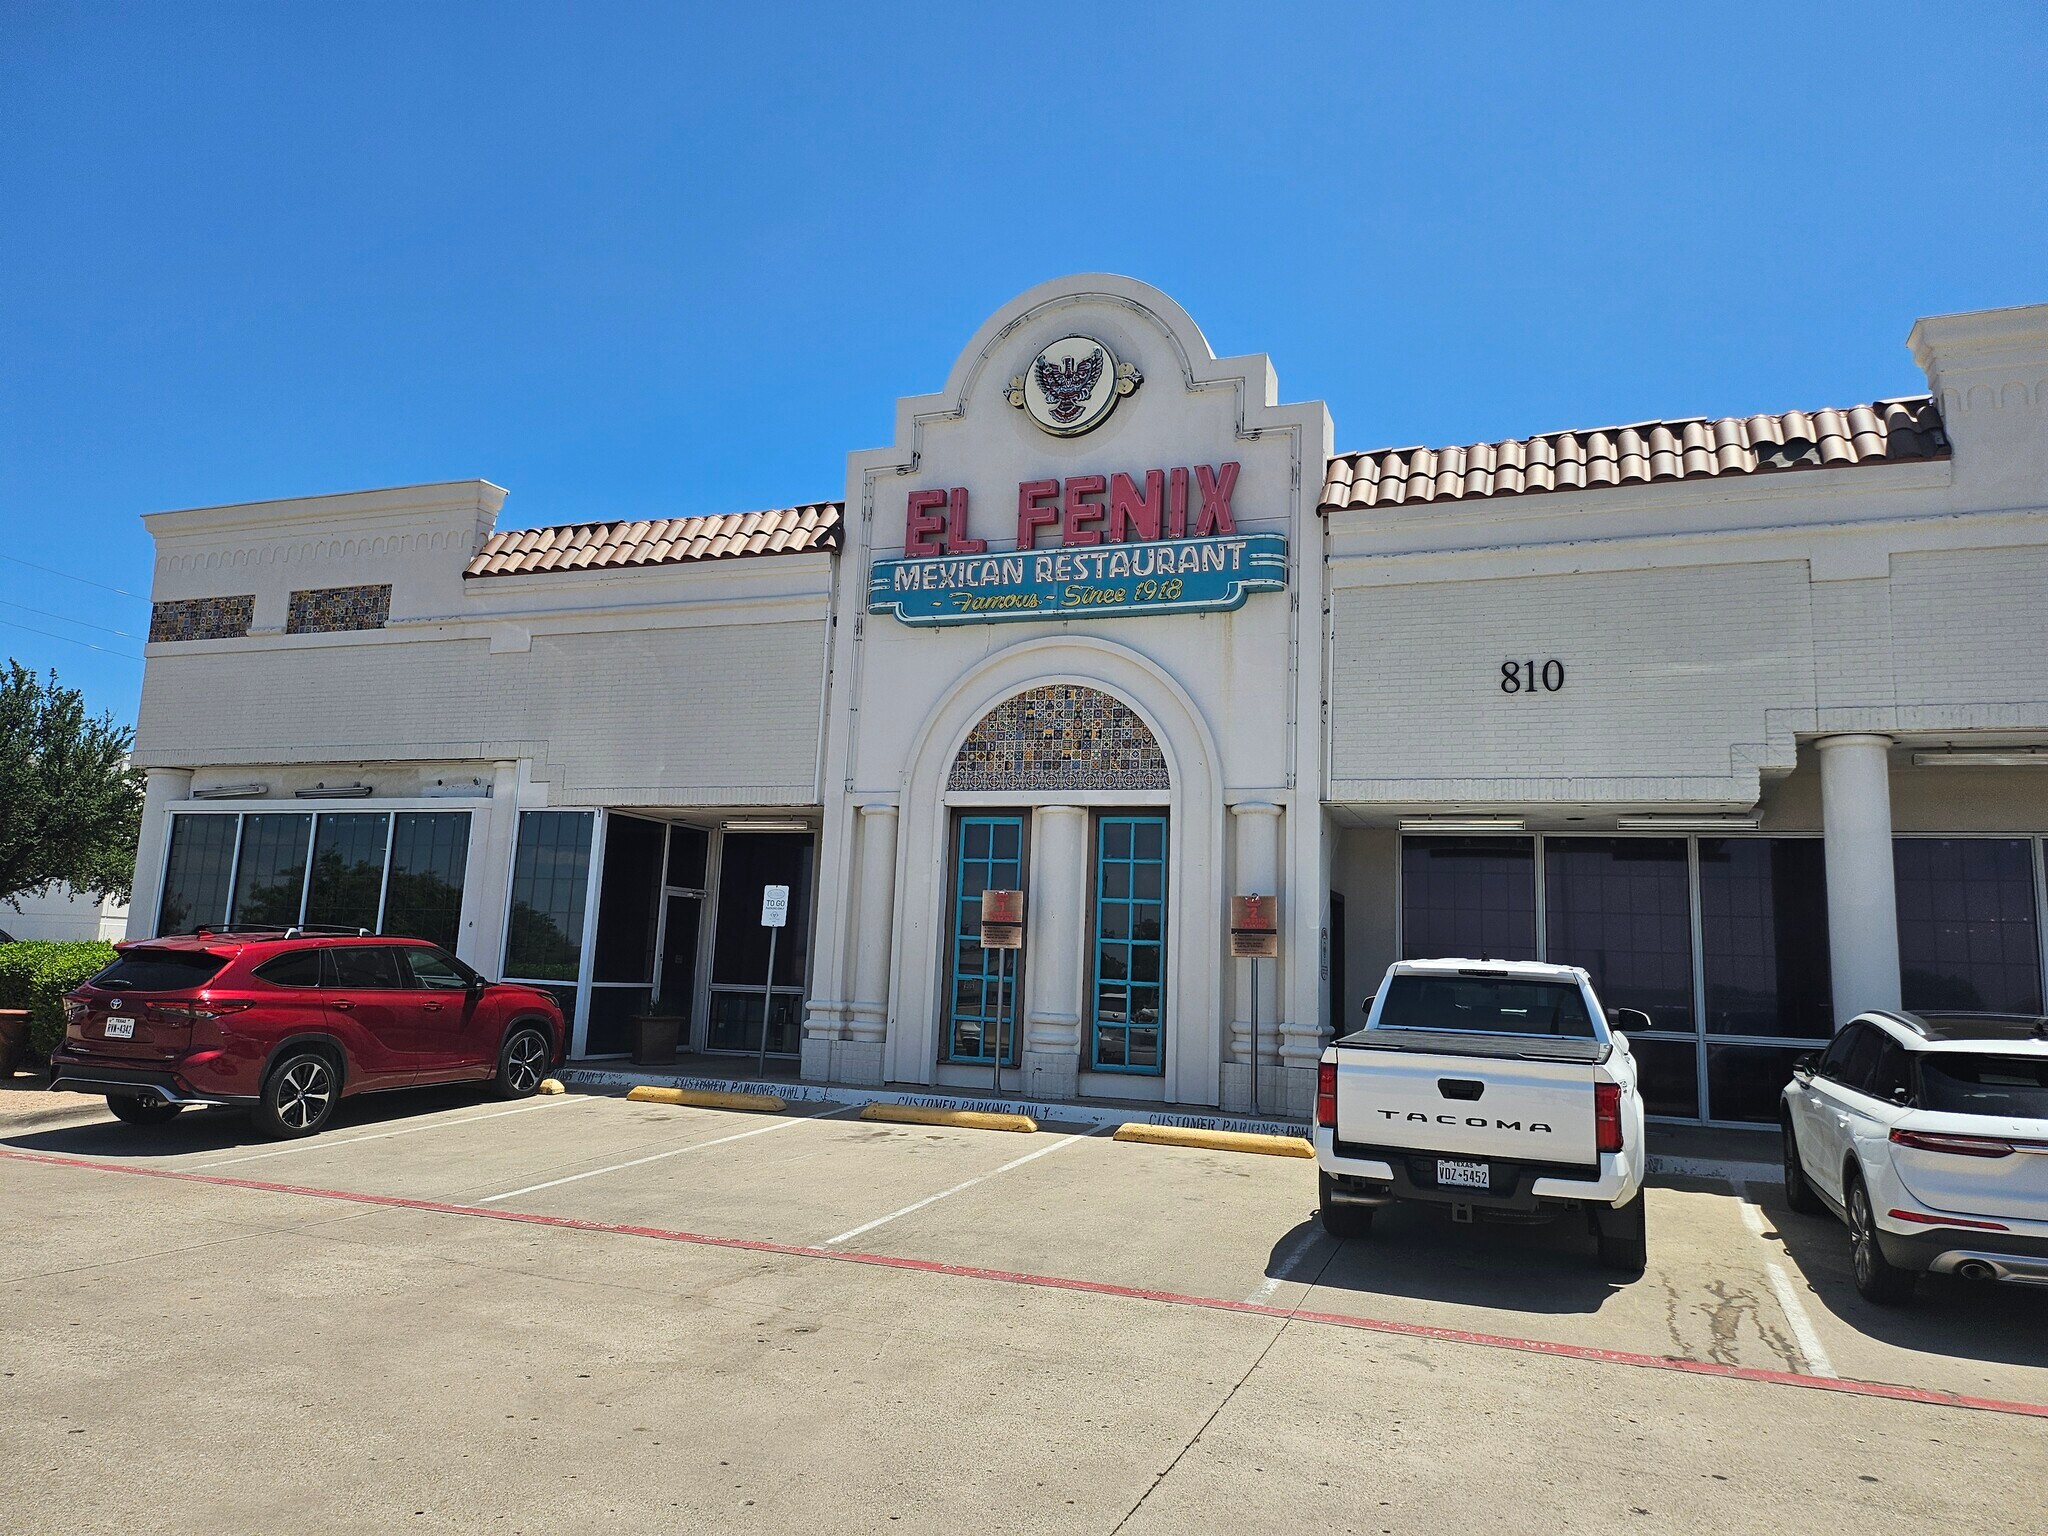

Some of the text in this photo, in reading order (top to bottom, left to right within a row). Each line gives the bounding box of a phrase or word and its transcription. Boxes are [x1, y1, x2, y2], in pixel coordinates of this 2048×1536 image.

[904, 461, 1241, 558] EL FENIX
[894, 541, 1247, 592] MEXICAN RESTAURANT
[949, 591, 1041, 613] Famous
[1060, 583, 1128, 607] Since
[1133, 577, 1184, 601] 1918
[1500, 659, 1565, 694] 810
[766, 899, 786, 907] TO GO
[673, 1077, 810, 1101] CUSTOMER PARKING ONLY
[895, 1096, 1051, 1119] CUSTOMER PARKING ONLY
[1148, 1113, 1216, 1130] CUSTOMER
[1377, 1109, 1552, 1133] TACOMA
